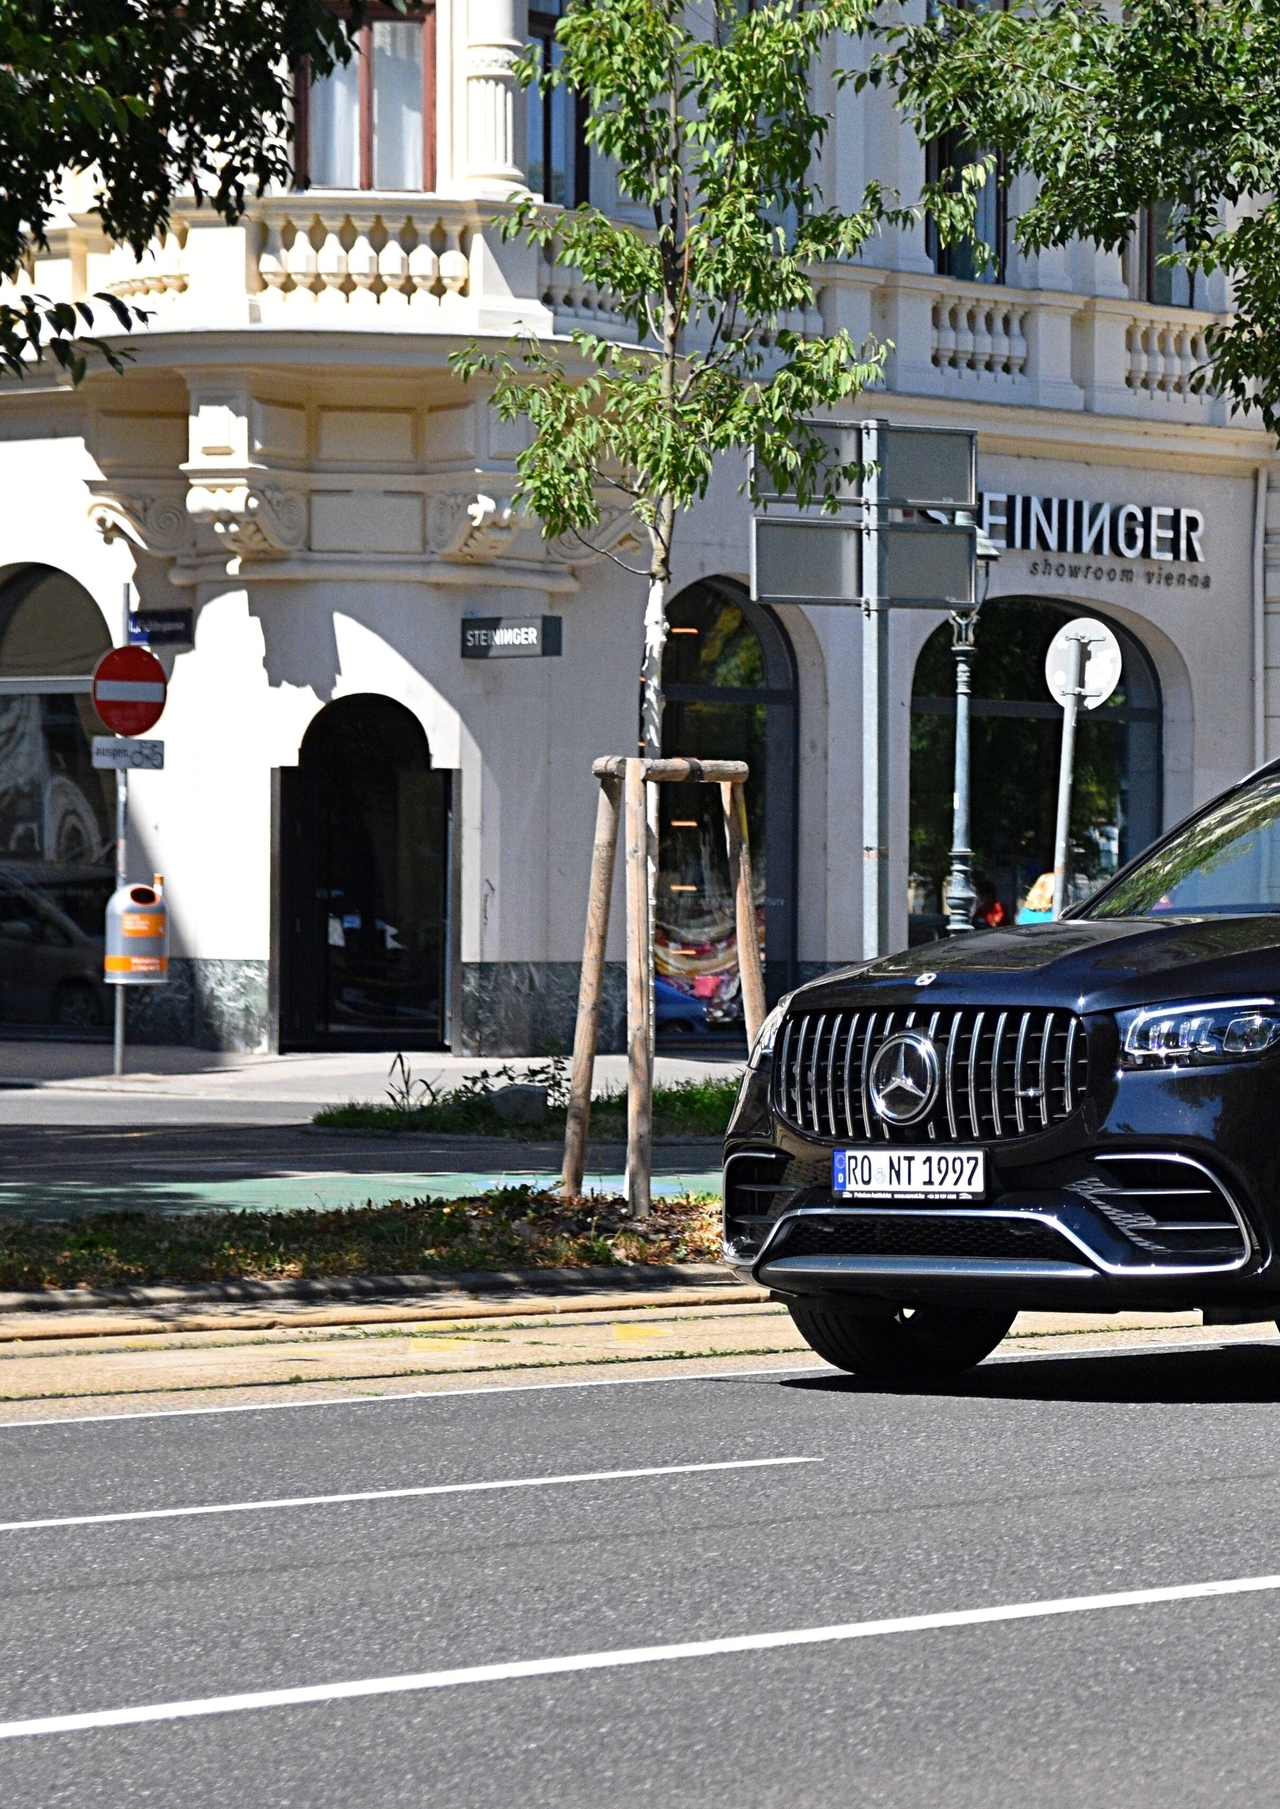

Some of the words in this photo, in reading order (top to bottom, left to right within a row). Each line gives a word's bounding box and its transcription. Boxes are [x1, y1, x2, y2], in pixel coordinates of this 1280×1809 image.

[927, 492, 1206, 563] EININGER
[1030, 558, 1134, 582] showroom
[1145, 566, 1211, 588] vienna
[466, 627, 538, 647] STEININGER
[837, 1172, 844, 1184] D
[847, 1154, 872, 1186] RO
[888, 1155, 915, 1186] NT
[922, 1155, 979, 1187] 1997
